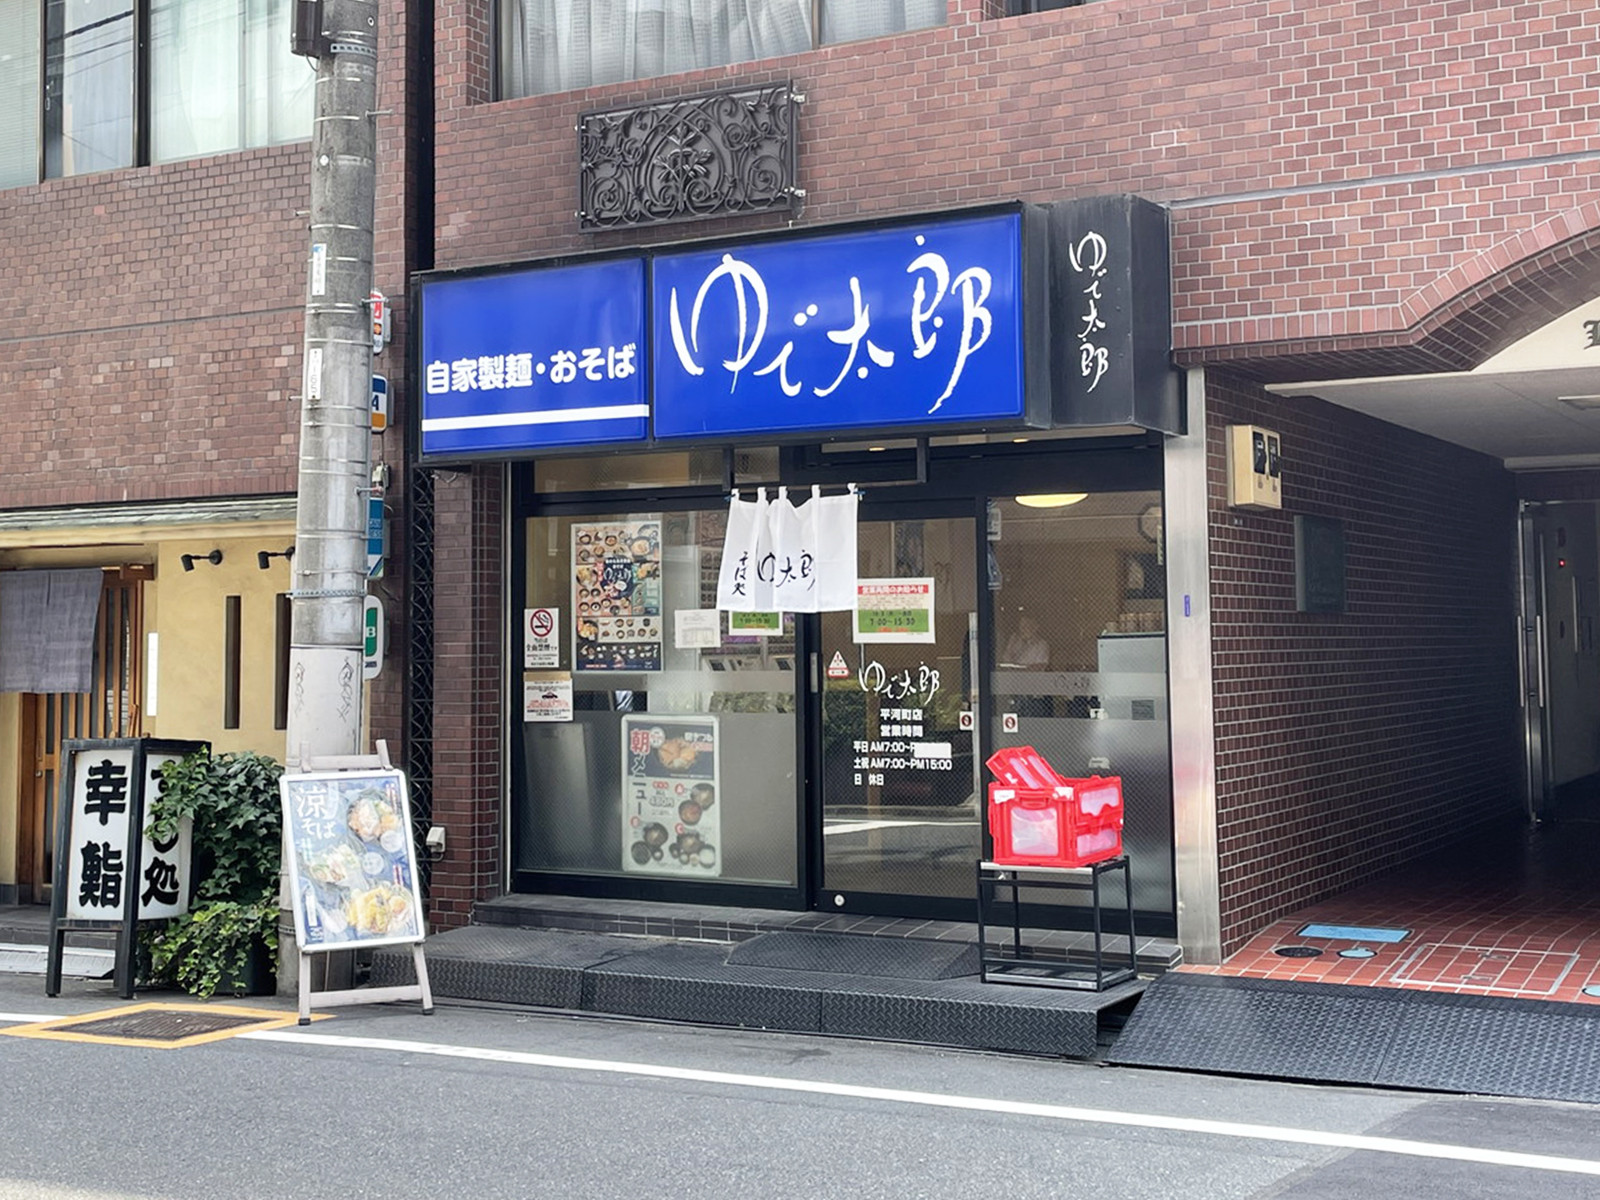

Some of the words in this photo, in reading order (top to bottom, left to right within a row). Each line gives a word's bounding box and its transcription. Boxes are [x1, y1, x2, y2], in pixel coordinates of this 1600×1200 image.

[668, 234, 994, 416] ゆで太郎
[1068, 231, 1110, 394] ゆで太郎
[424, 341, 638, 394] 自家製麺・おそば
[858, 660, 940, 706] ゆで太郎
[880, 708, 923, 721] 平河町店
[880, 724, 923, 737] 営業時間
[853, 741, 869, 752] 平日
[854, 773, 862, 785] 日
